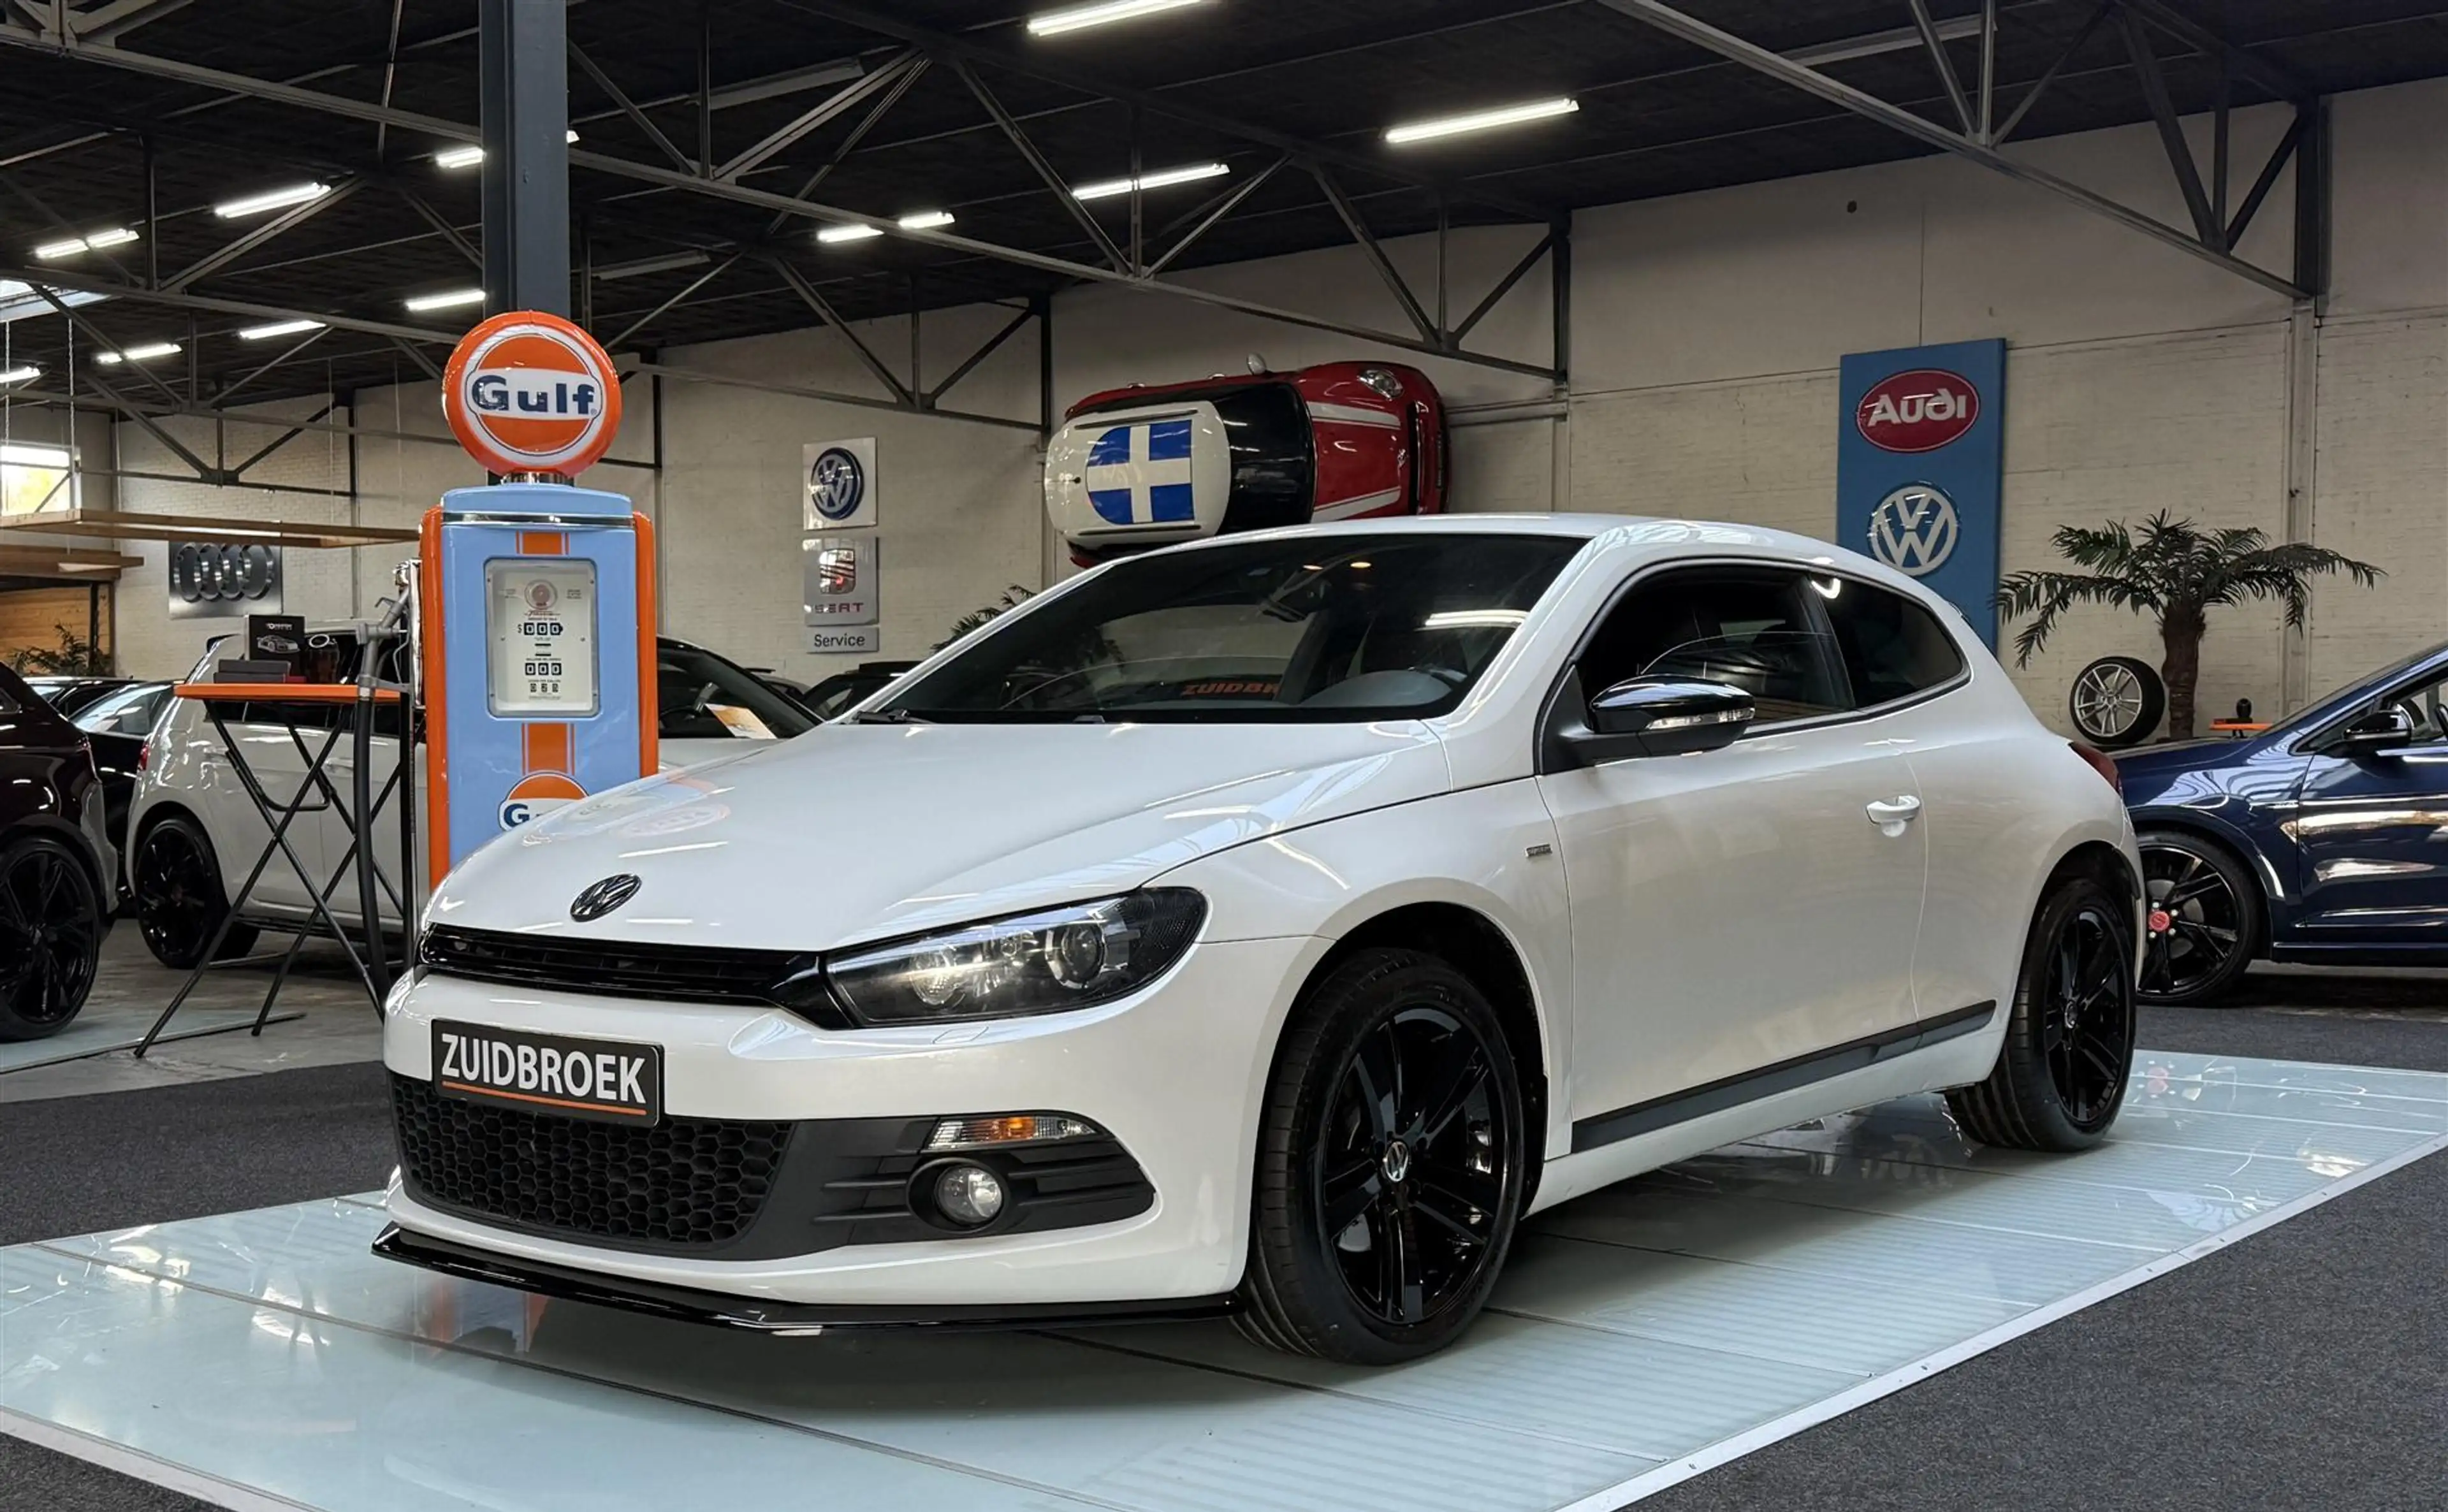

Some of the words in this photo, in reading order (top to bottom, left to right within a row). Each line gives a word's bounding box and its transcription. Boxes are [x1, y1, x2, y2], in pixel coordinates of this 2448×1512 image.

[472, 375, 594, 414] Gulf
[815, 602, 864, 614] SEAT
[813, 632, 866, 648] Service
[441, 1033, 646, 1104] ZUIDBROEK
